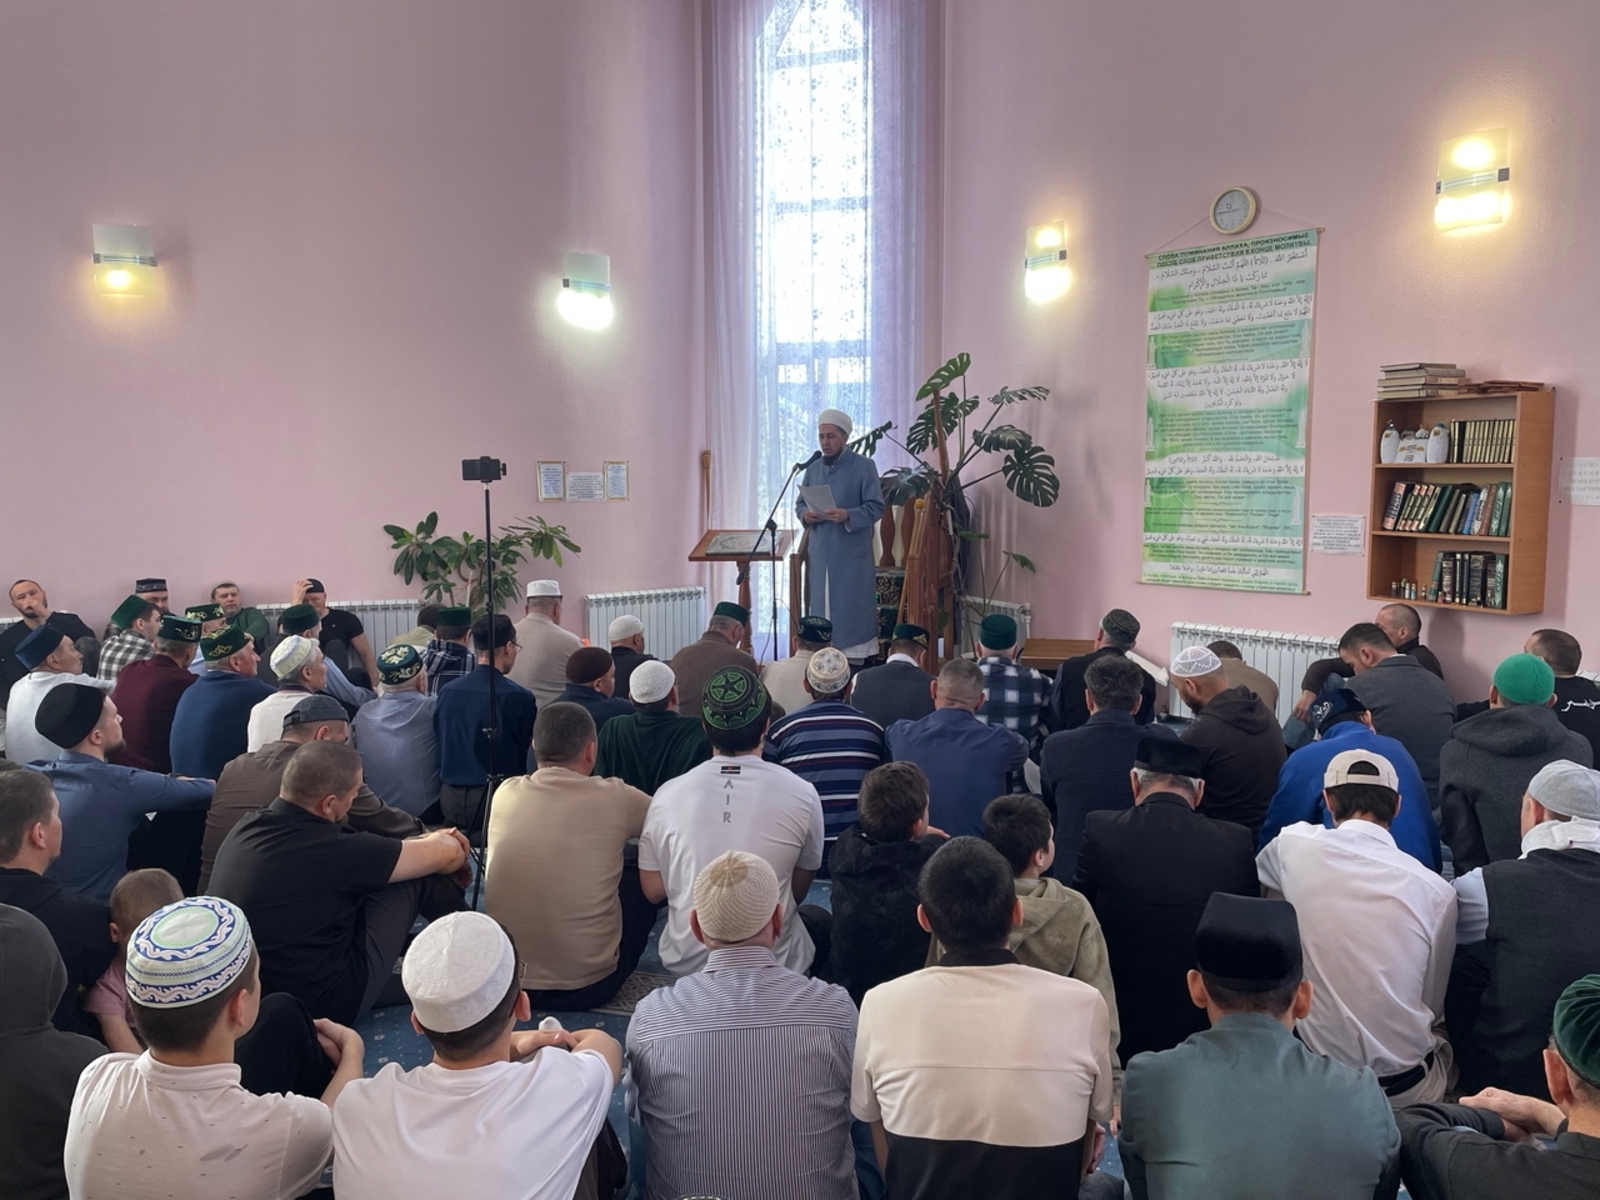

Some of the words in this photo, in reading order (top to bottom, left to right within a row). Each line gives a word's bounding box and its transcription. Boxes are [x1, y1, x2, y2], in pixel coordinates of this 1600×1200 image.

[1251, 232, 1309, 246] ПРОИЗНОСИМЫЕ
[1157, 259, 1177, 268] ПОСЛЕ
[1251, 245, 1273, 255] КОНЦЕ
